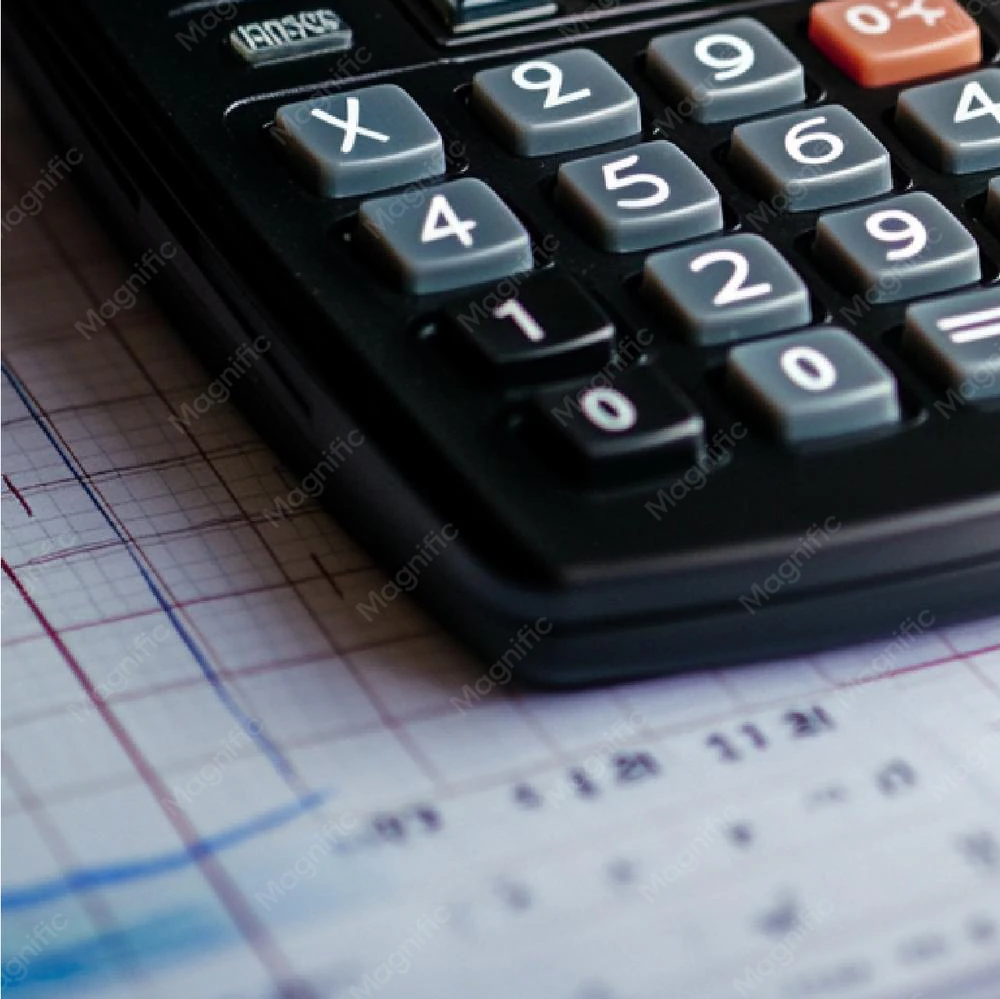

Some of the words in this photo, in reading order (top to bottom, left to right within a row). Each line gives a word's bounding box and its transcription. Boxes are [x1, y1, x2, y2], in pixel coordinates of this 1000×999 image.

[694, 34, 755, 82] 9
[784, 116, 844, 165] 6
[601, 154, 670, 208] 5
[421, 194, 477, 247] 4
[865, 209, 927, 261] 9
[690, 251, 771, 305] 2
[494, 299, 544, 341] 1
[781, 346, 836, 391] 0
[580, 387, 637, 431] 0
